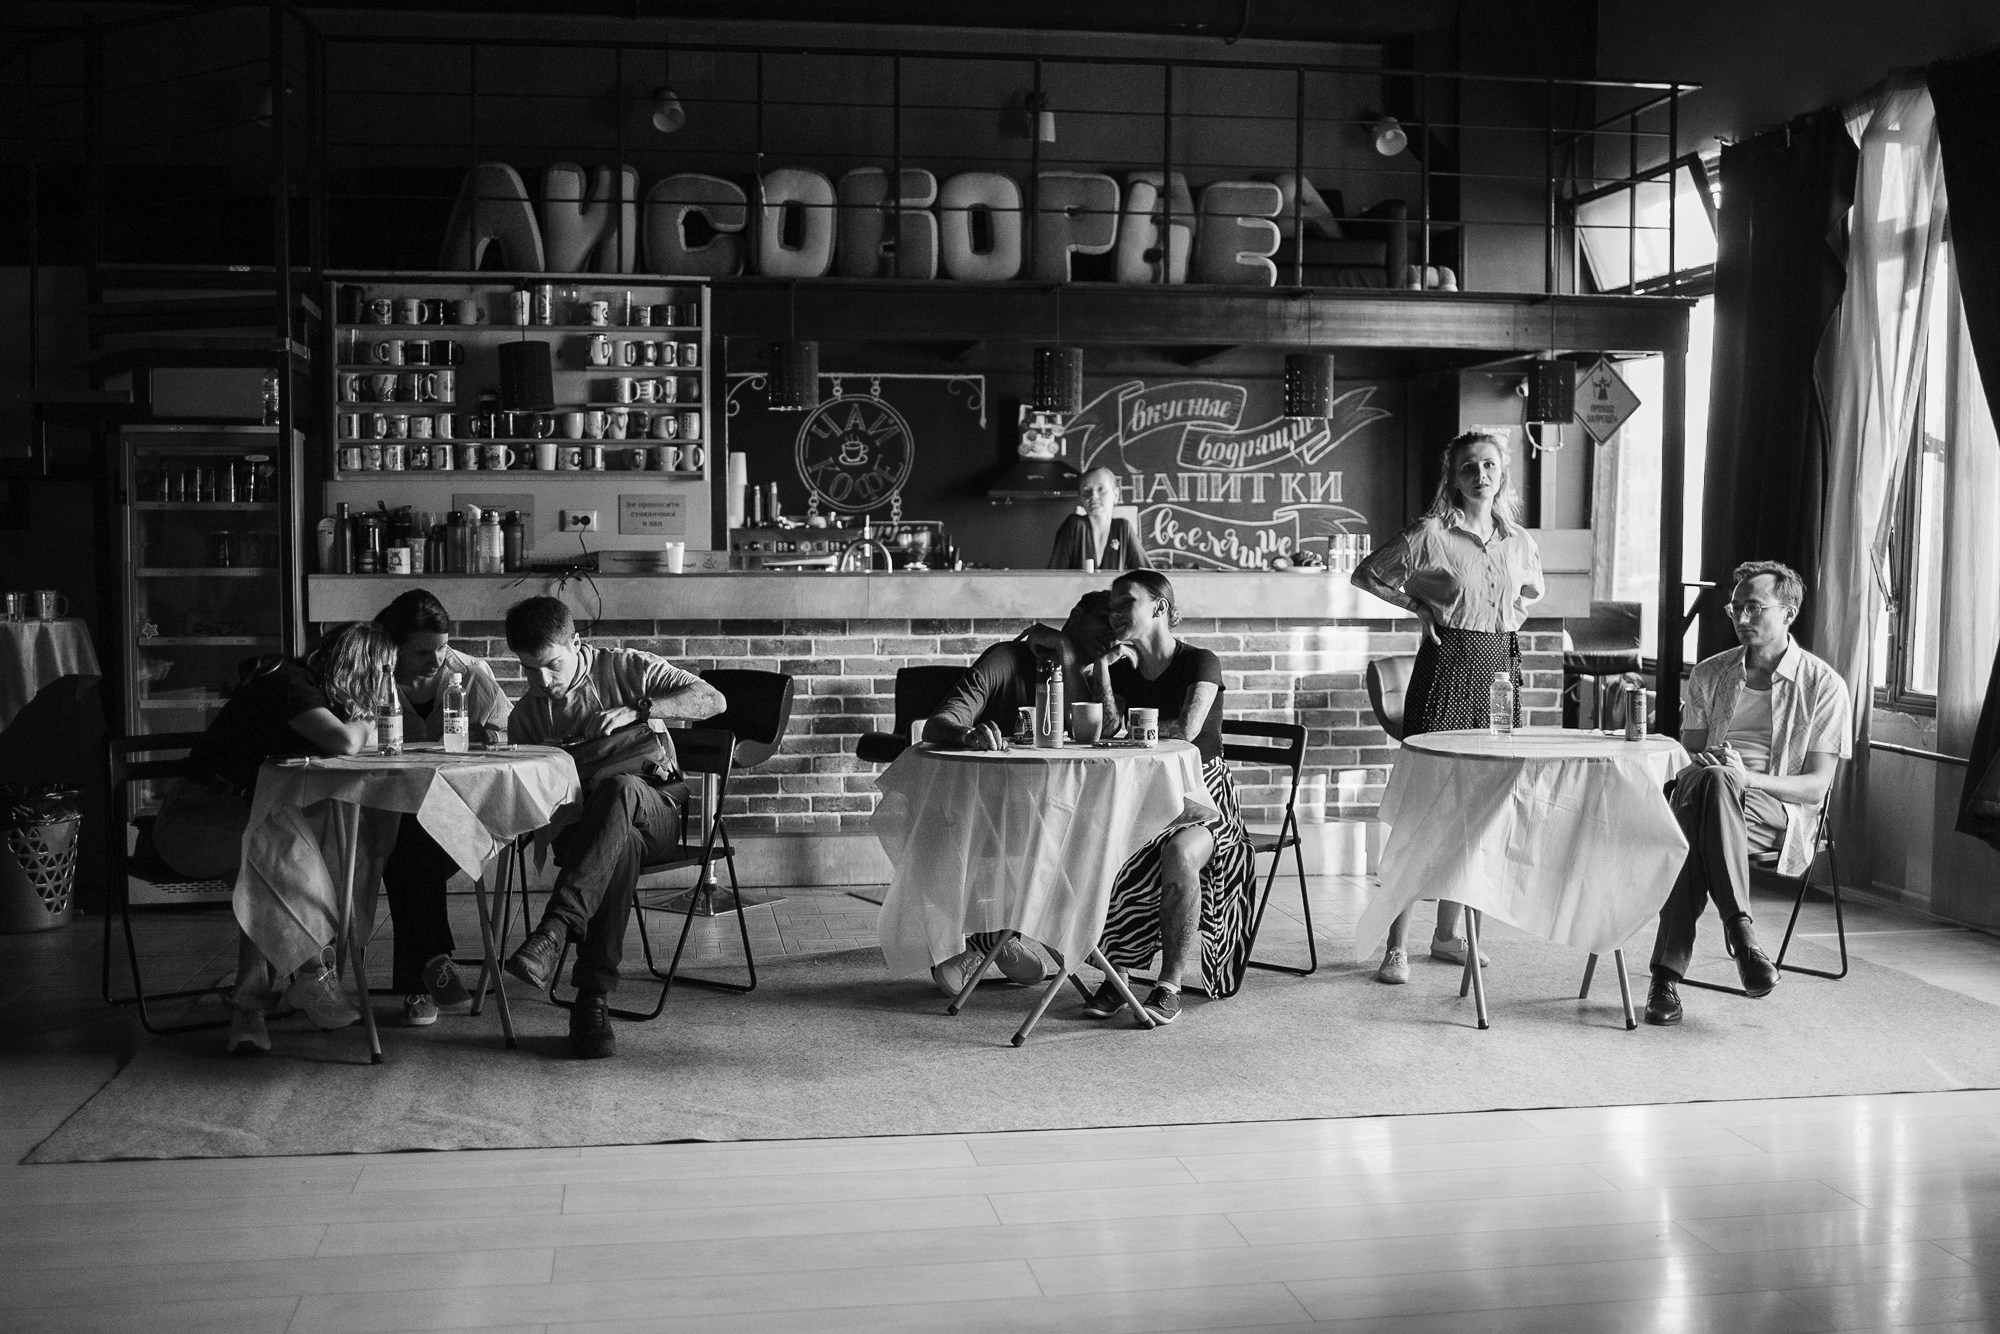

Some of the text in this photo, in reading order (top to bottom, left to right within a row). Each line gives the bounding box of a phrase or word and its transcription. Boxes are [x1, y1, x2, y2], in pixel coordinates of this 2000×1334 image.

[810, 402, 900, 446] ЧАЙ
[1131, 398, 1232, 432] вкусные
[807, 453, 904, 502] КОФЕ
[1117, 471, 1344, 503] НАПИТКИ
[1149, 507, 1292, 571] веселящие
